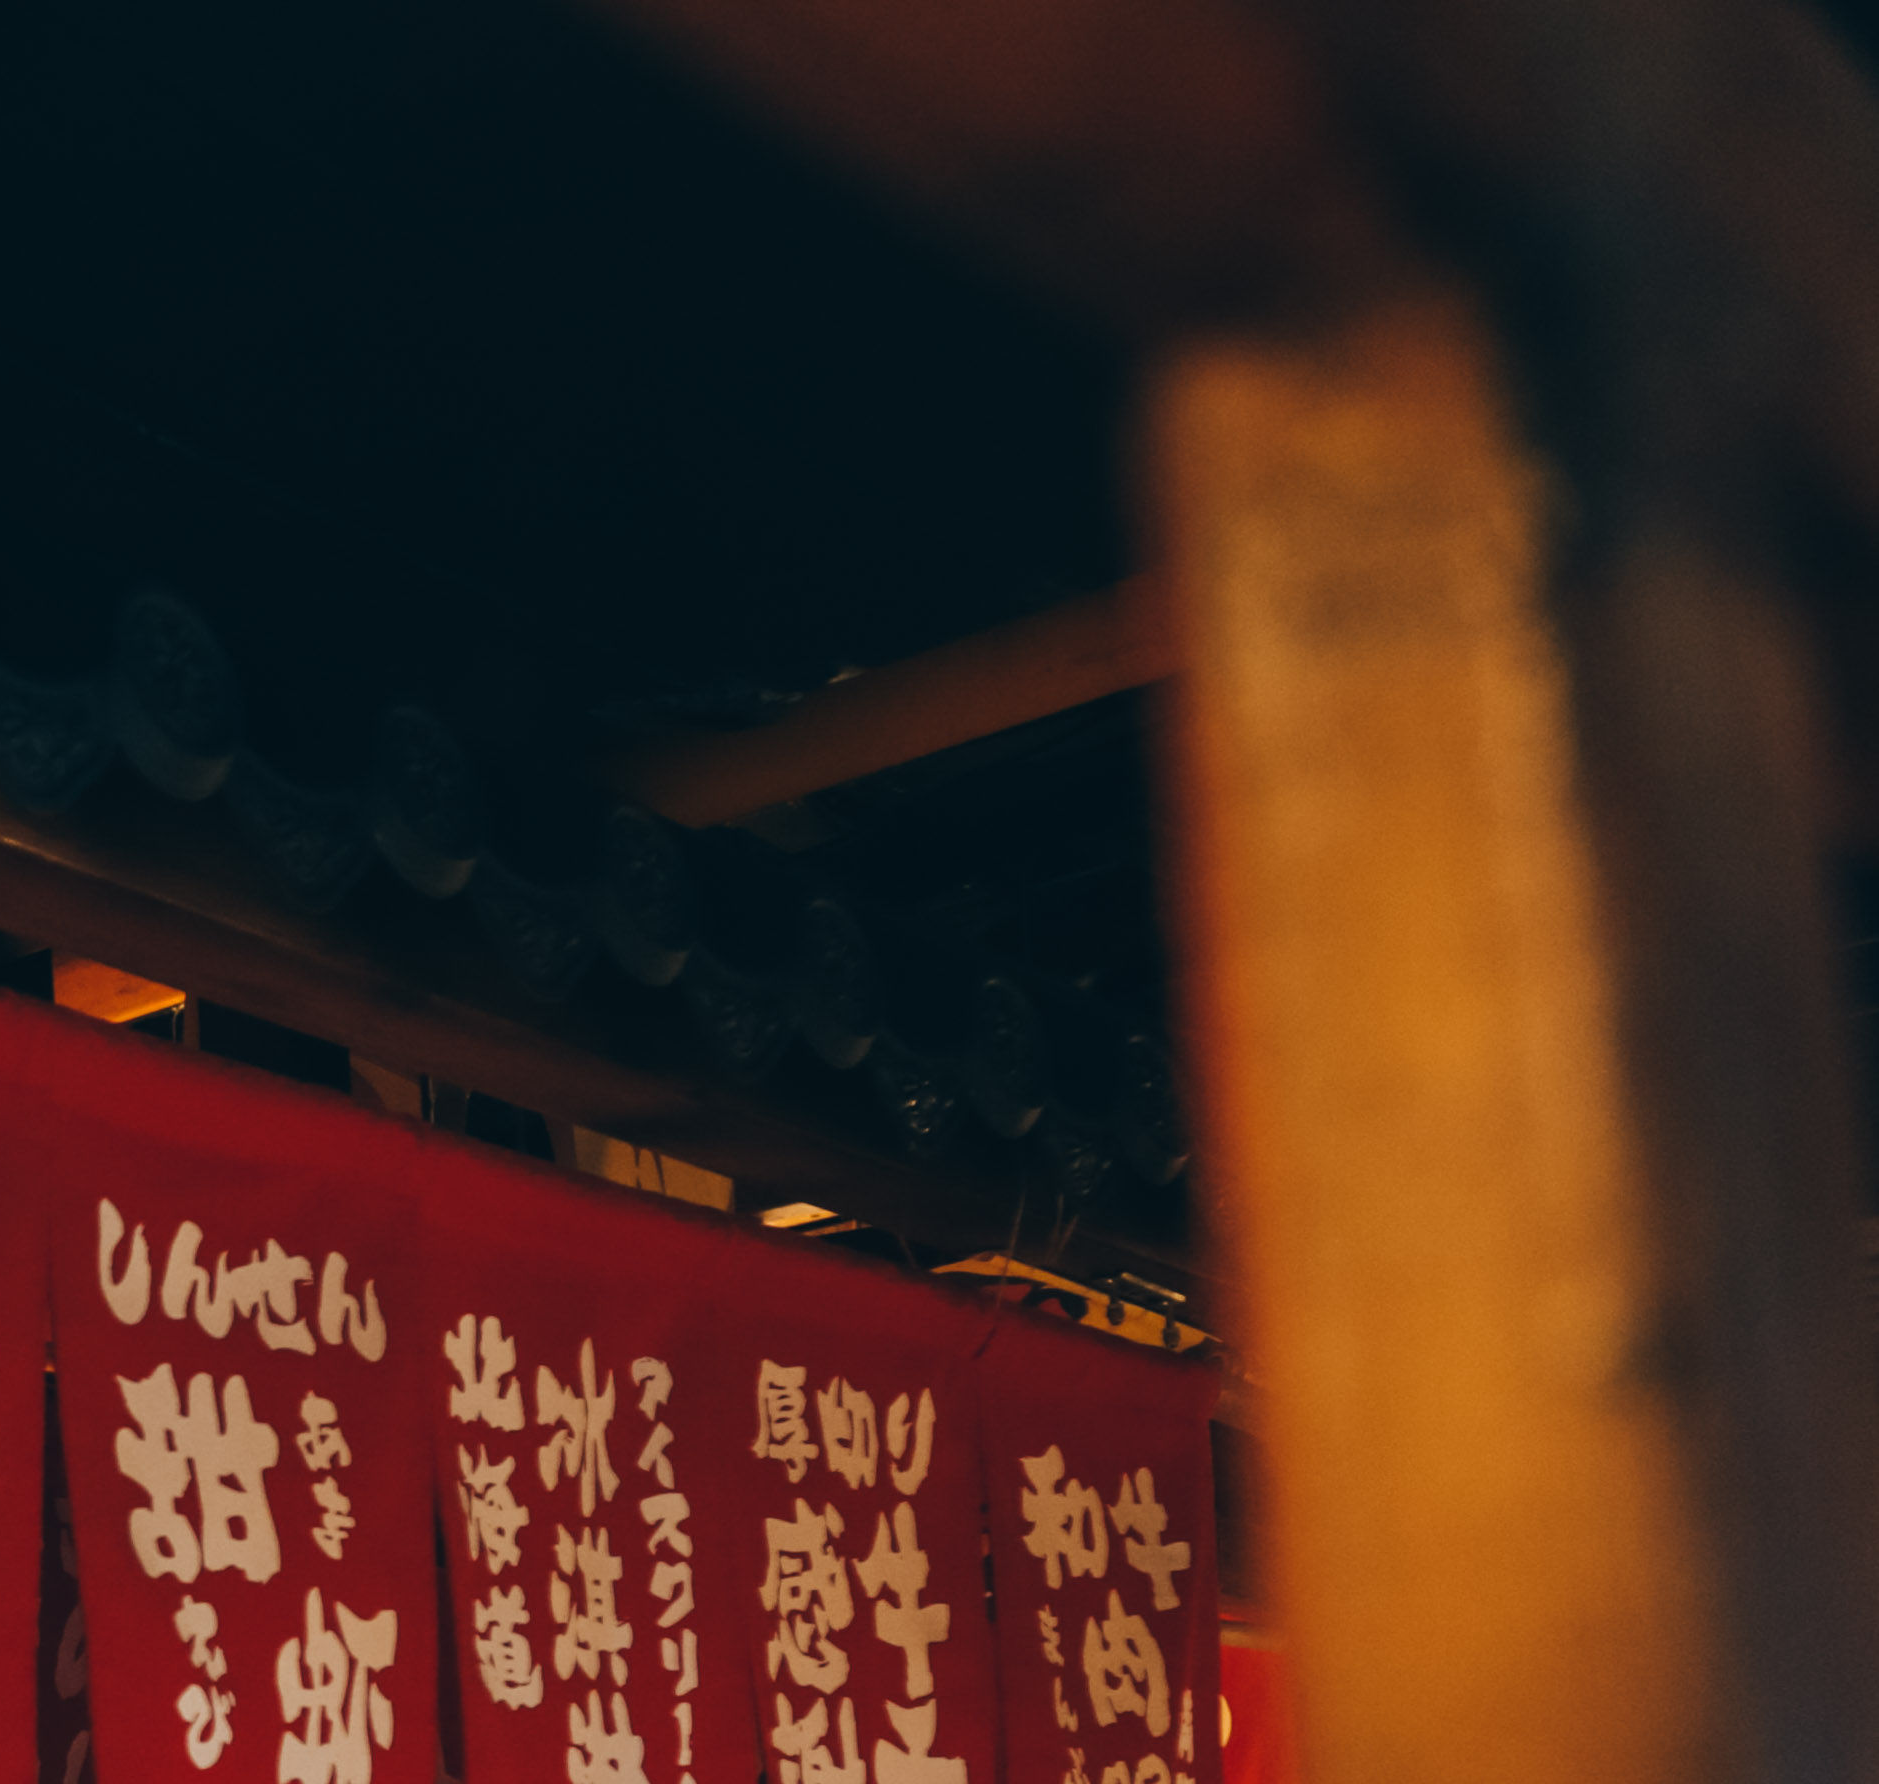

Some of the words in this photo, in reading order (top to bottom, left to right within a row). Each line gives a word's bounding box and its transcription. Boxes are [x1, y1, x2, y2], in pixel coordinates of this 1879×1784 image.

[99, 1196, 386, 1362] しんせん
[443, 1313, 543, 1712] 北海道
